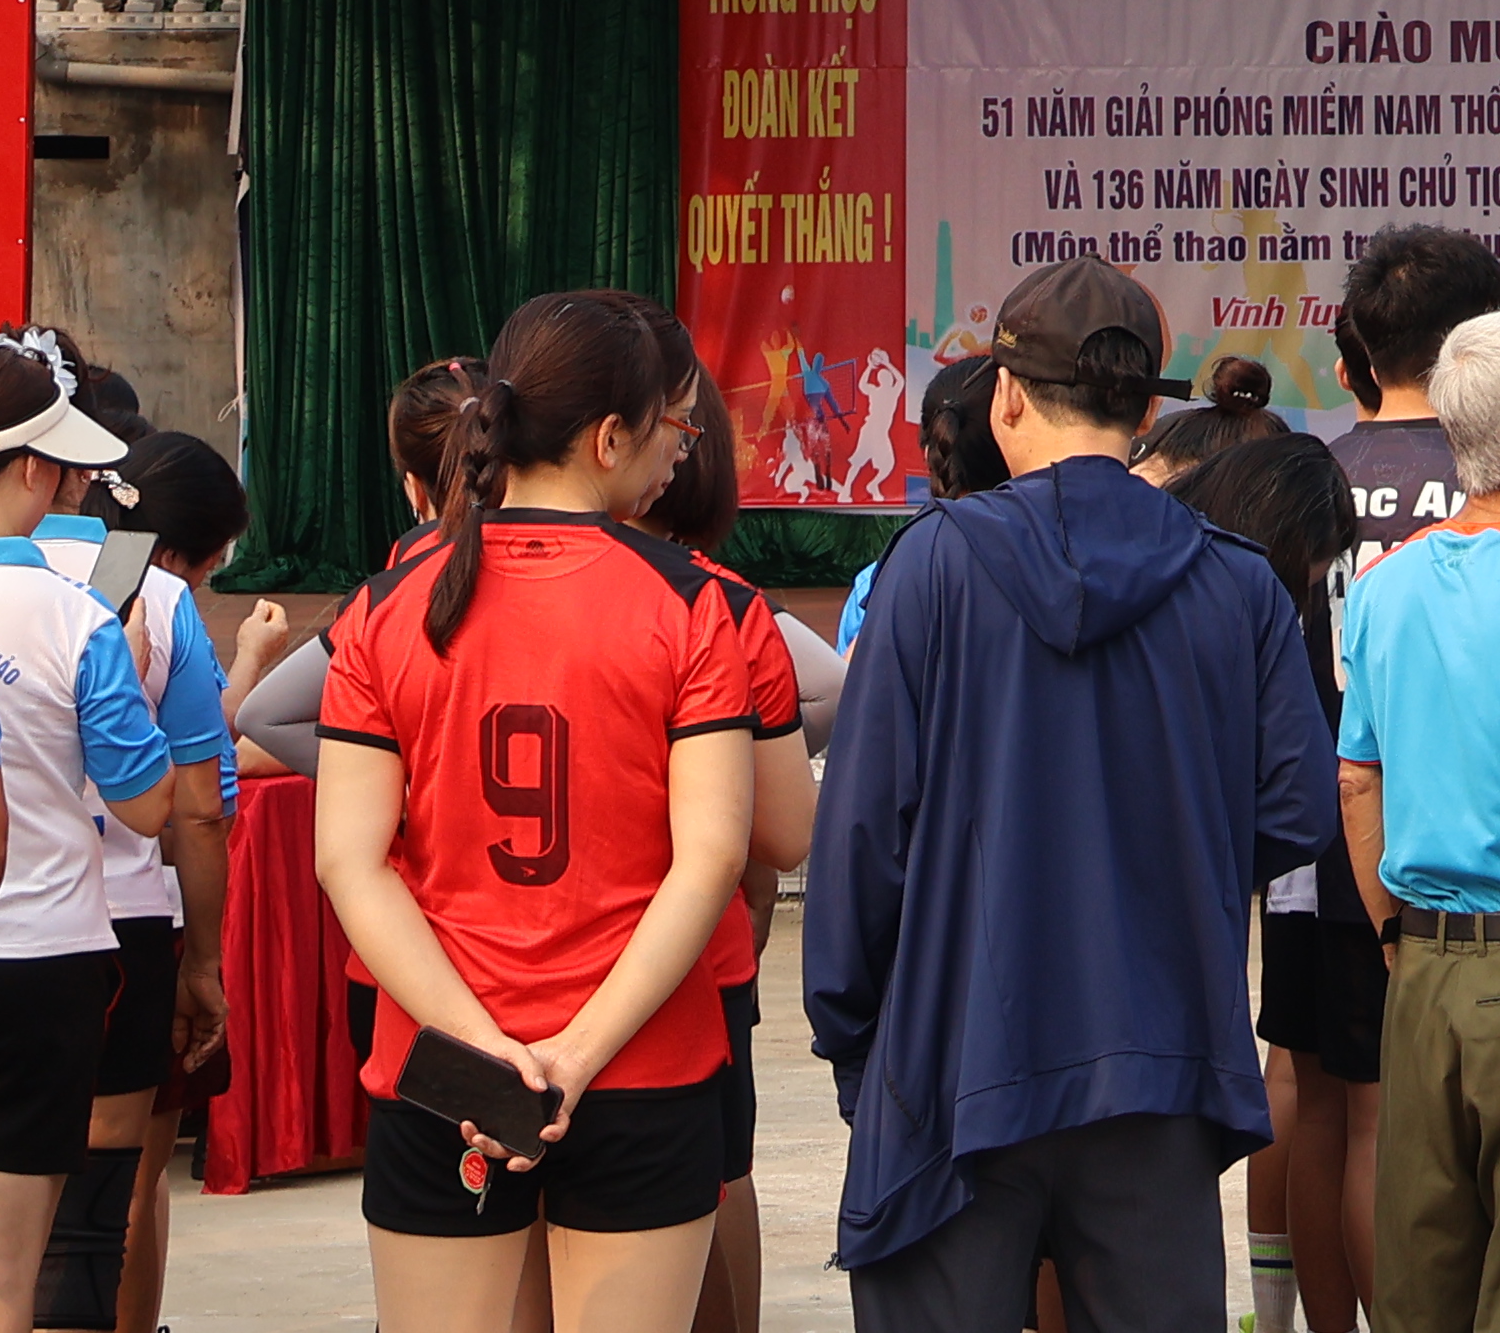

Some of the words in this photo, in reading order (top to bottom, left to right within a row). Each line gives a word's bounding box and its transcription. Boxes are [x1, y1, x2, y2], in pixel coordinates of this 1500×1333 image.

[1305, 11, 1432, 64] CHÀO
[722, 53, 798, 139] ĐOÀN
[808, 45, 859, 137] KẾT
[982, 97, 1013, 137] 51
[1028, 88, 1095, 137] NĂM
[1106, 82, 1163, 136] GIẢI
[1174, 87, 1273, 136] PHÓNG
[1283, 81, 1364, 136] MIỀM
[1374, 95, 1441, 135] NAM
[1045, 160, 1082, 210] VÀ
[1093, 169, 1143, 210] 136
[1155, 159, 1221, 209] NĂM
[1232, 159, 1310, 209] NGÀY
[1320, 167, 1389, 208] SINH
[1400, 153, 1456, 207] CHỦ
[687, 170, 773, 273] QUYẾT
[781, 166, 873, 263] THẮNG
[884, 193, 891, 262] !
[1012, 231, 1098, 266] (Môn
[1109, 223, 1163, 263] thể
[1174, 231, 1246, 263] thao
[1259, 222, 1331, 262] nằm
[1212, 296, 1285, 327] Vĩnh
[479, 703, 570, 887] 9
